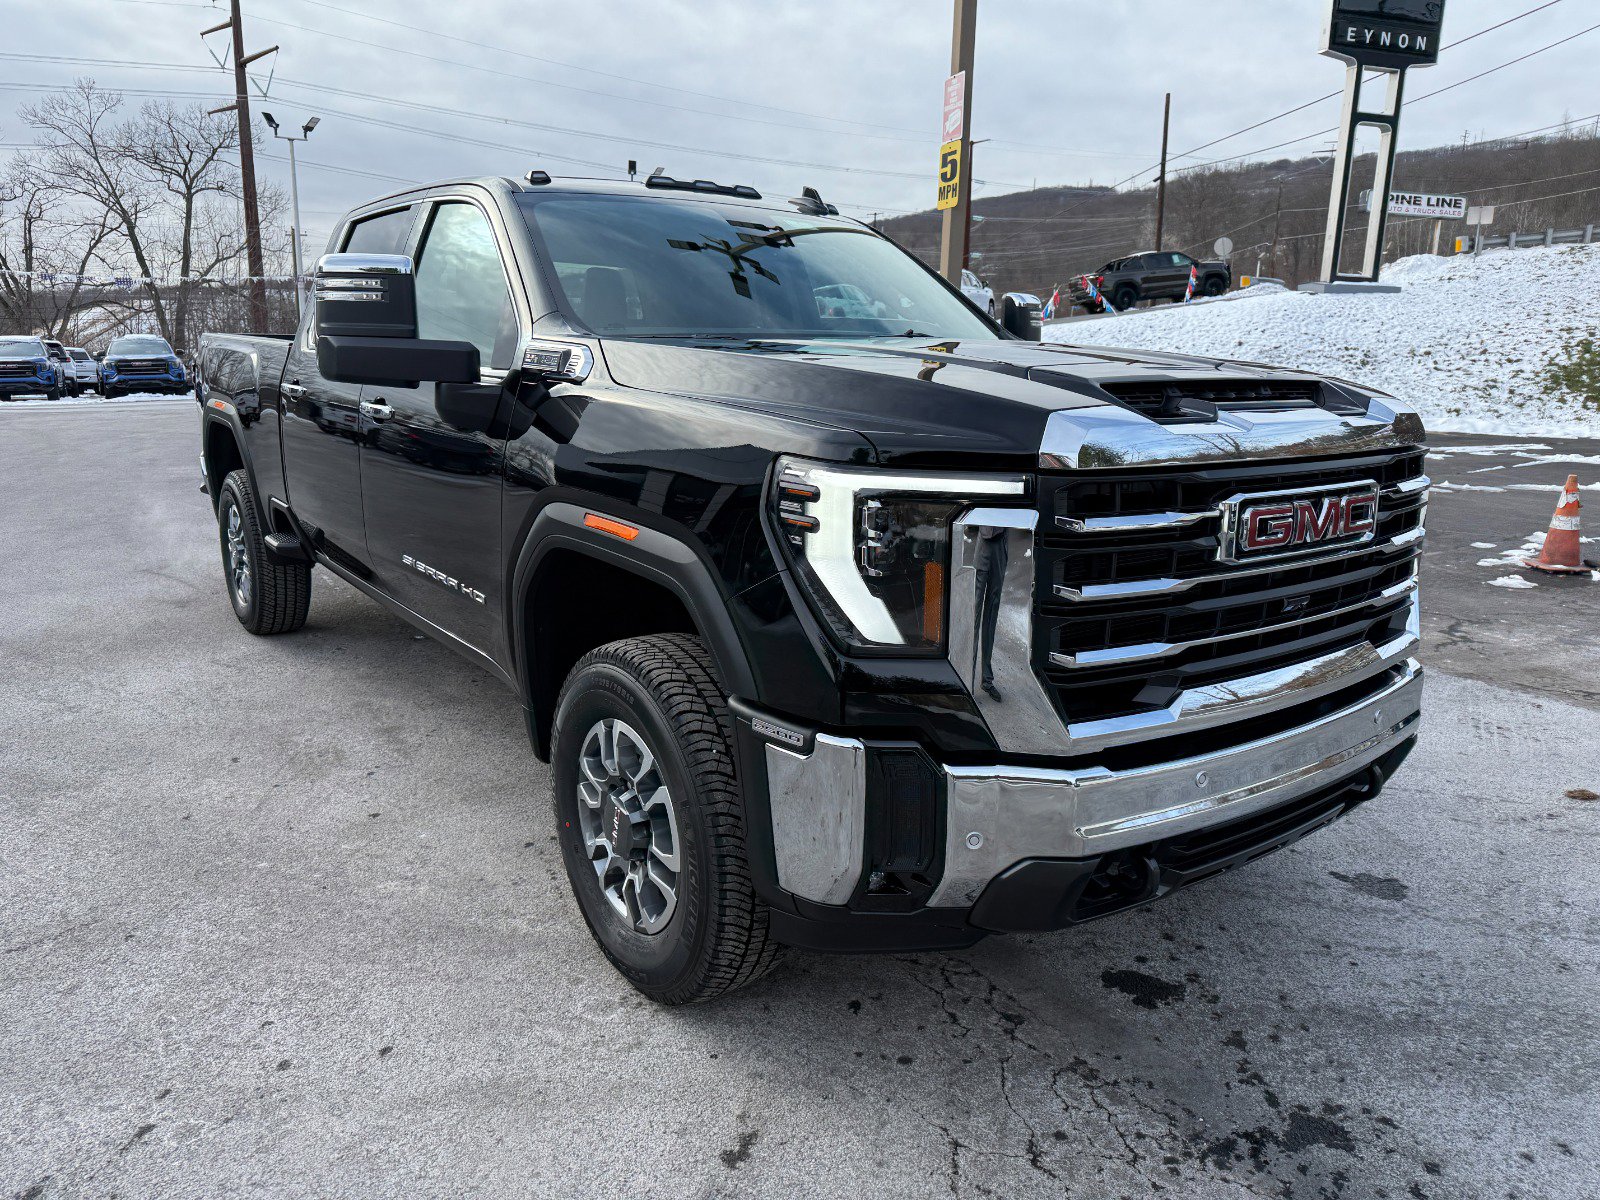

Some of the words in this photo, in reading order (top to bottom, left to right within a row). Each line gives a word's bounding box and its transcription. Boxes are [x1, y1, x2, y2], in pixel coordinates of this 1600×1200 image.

[1346, 27, 1427, 50] EYNON
[940, 150, 957, 183] 5
[938, 183, 957, 201] MPH
[1427, 197, 1463, 208] LINE
[1239, 494, 1375, 551] GMC
[402, 554, 459, 589] SIERRA
[460, 583, 486, 605] HD
